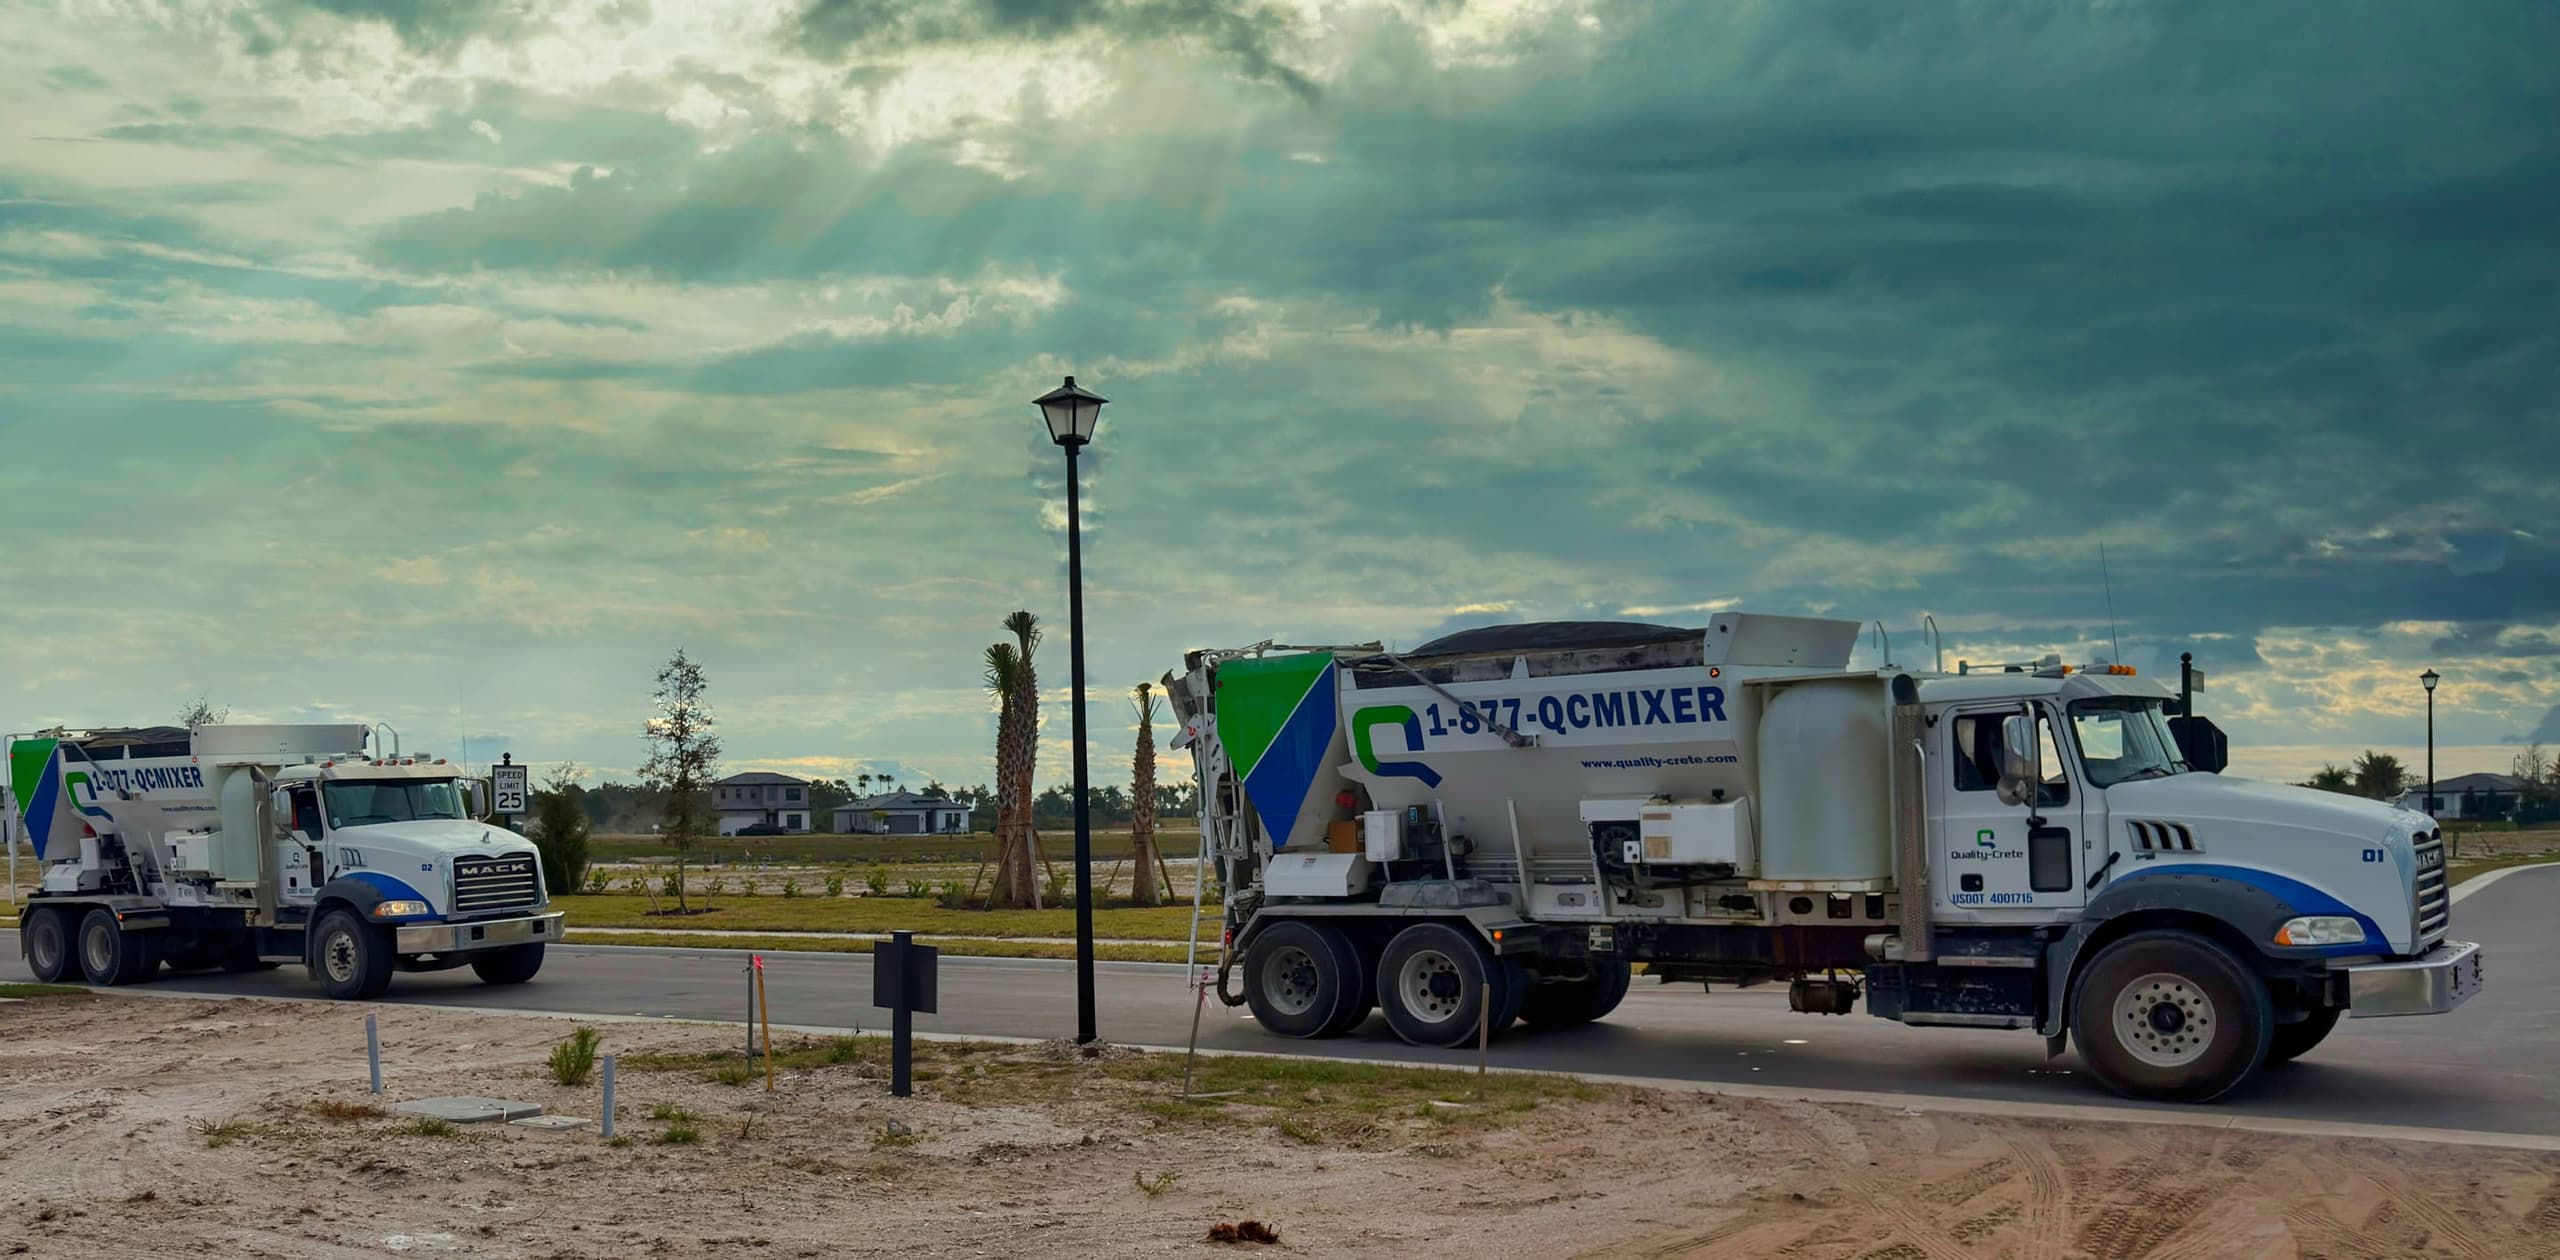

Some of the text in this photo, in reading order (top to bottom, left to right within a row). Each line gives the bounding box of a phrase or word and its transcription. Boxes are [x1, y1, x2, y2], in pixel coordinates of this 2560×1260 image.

[1426, 685, 1728, 736] 1-877-QCMIXER
[1581, 754, 1738, 769] www.quality-crete.com
[496, 771, 523, 779] SPEED
[500, 782, 520, 790] LIMIT
[498, 792, 522, 809] 25
[1951, 850, 2024, 861] Quality-Crete
[2362, 849, 2384, 863] 01
[421, 863, 433, 872] 02
[461, 863, 528, 875] MACK
[1952, 893, 2033, 904] USDOT 4001715
